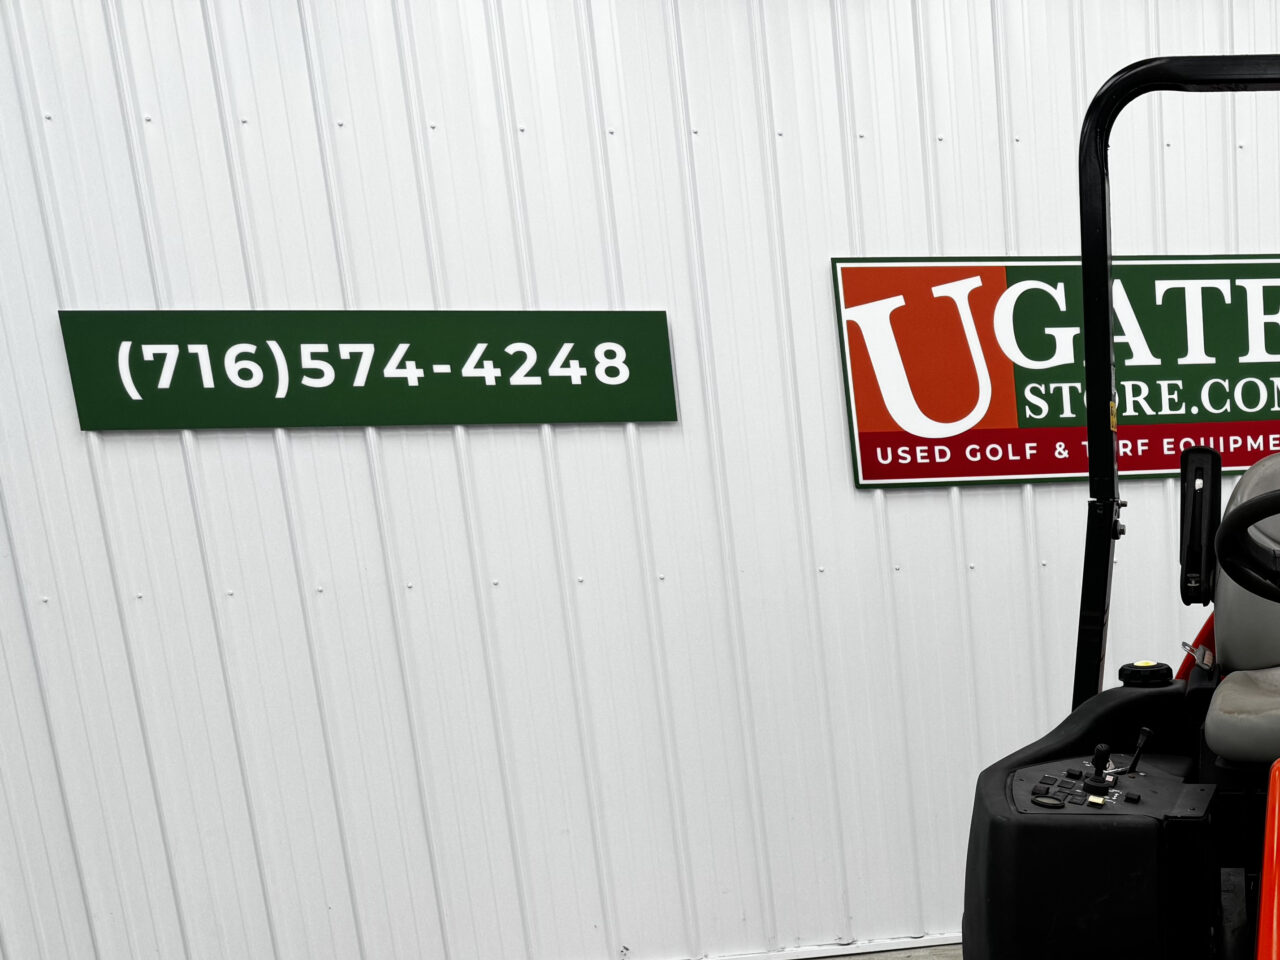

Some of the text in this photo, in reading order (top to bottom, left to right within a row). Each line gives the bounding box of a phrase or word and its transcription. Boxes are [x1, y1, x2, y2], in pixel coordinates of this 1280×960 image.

[117, 340, 631, 400] (716)574-4248
[876, 445, 951, 465] USED
[965, 443, 1038, 462] GOLF
[1054, 441, 1069, 460] &
